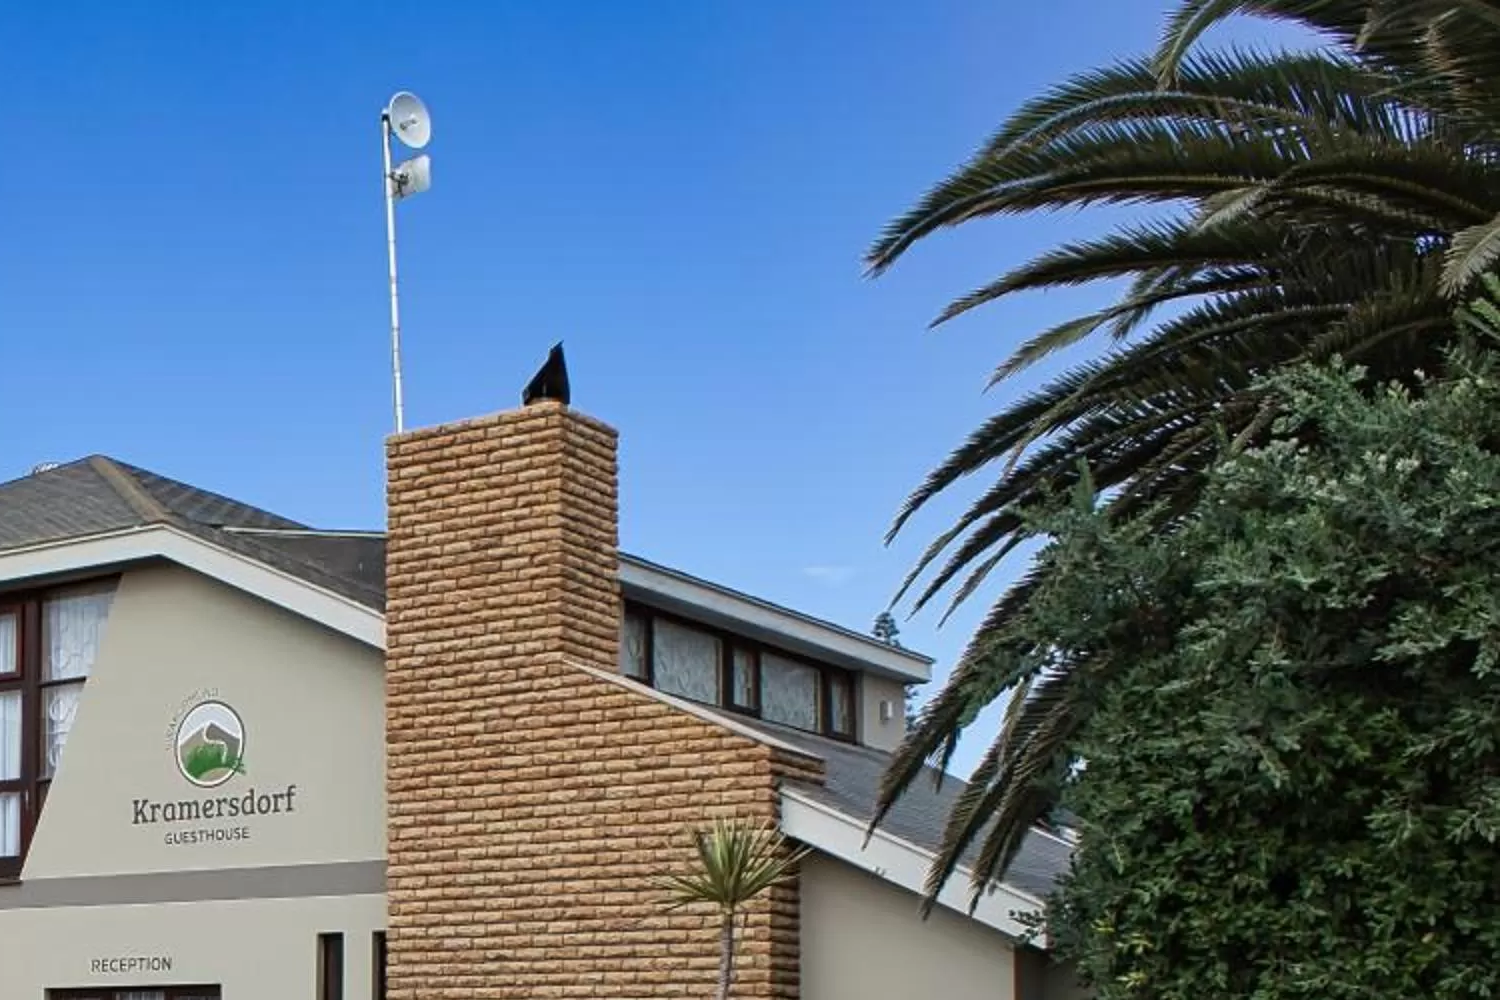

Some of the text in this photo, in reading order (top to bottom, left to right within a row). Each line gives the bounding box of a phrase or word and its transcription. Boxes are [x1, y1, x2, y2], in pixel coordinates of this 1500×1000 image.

[132, 784, 296, 825] Kramersdorf
[164, 827, 250, 845] GUESTHOUSE
[91, 957, 173, 973] RECEPTION
